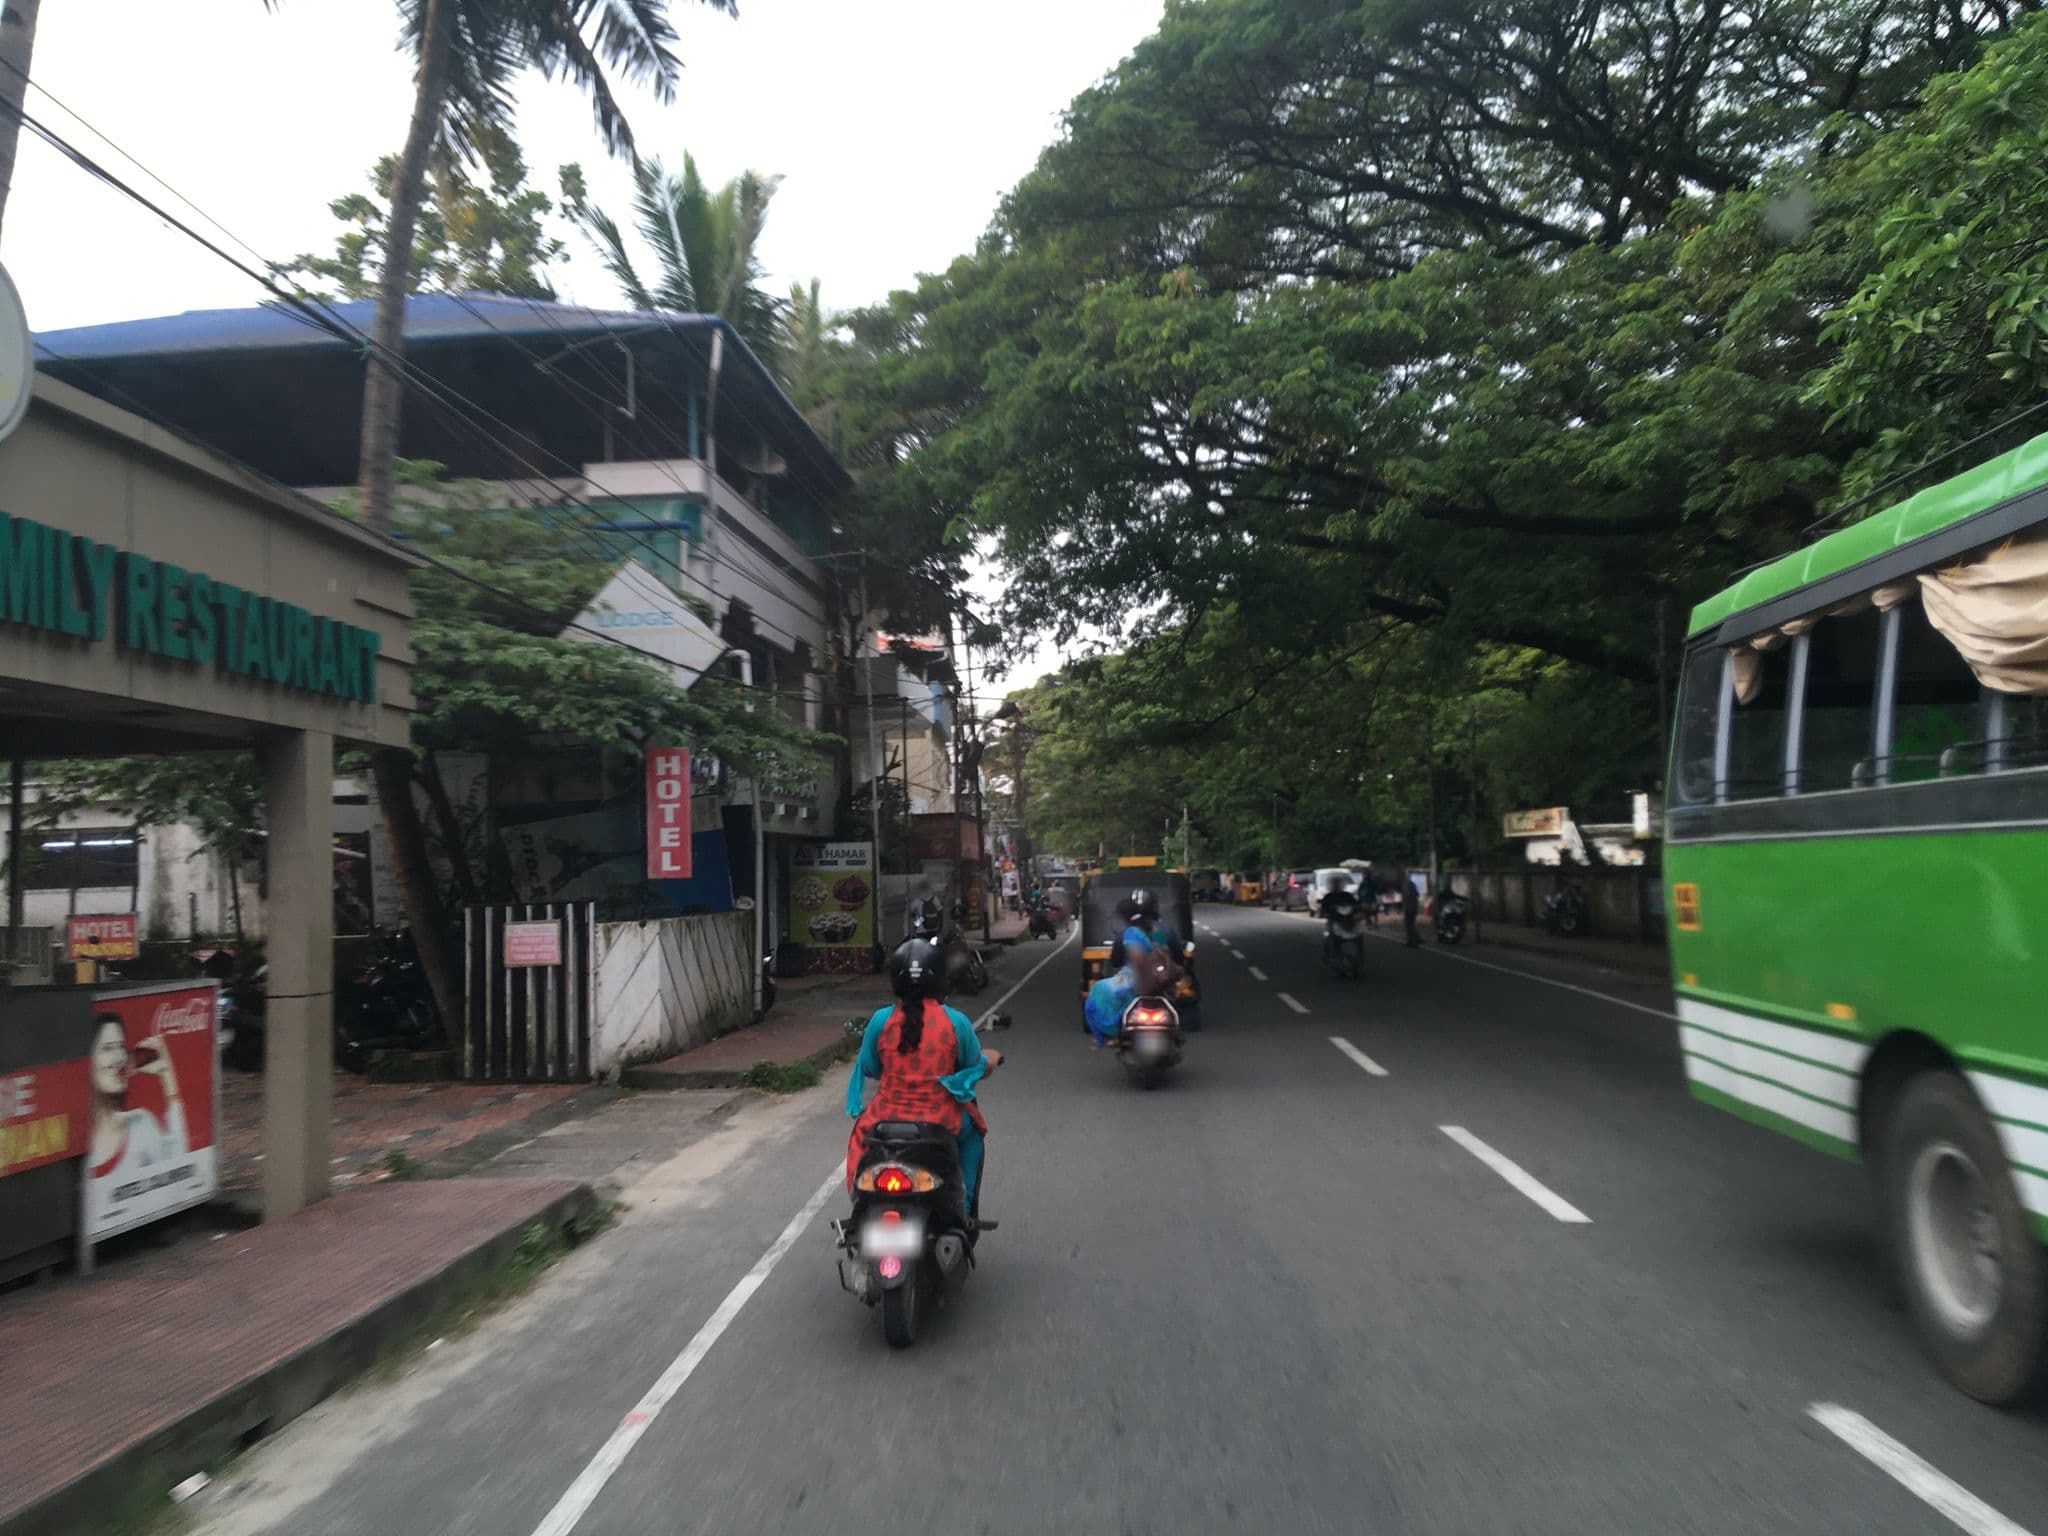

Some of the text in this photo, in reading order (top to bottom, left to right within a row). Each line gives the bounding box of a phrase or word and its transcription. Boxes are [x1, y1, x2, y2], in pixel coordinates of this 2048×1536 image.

[122, 551, 381, 704] RESTAURANT
[594, 611, 673, 628] LODGE
[656, 755, 681, 872] HOTEL
[72, 921, 133, 940] HOTEL
